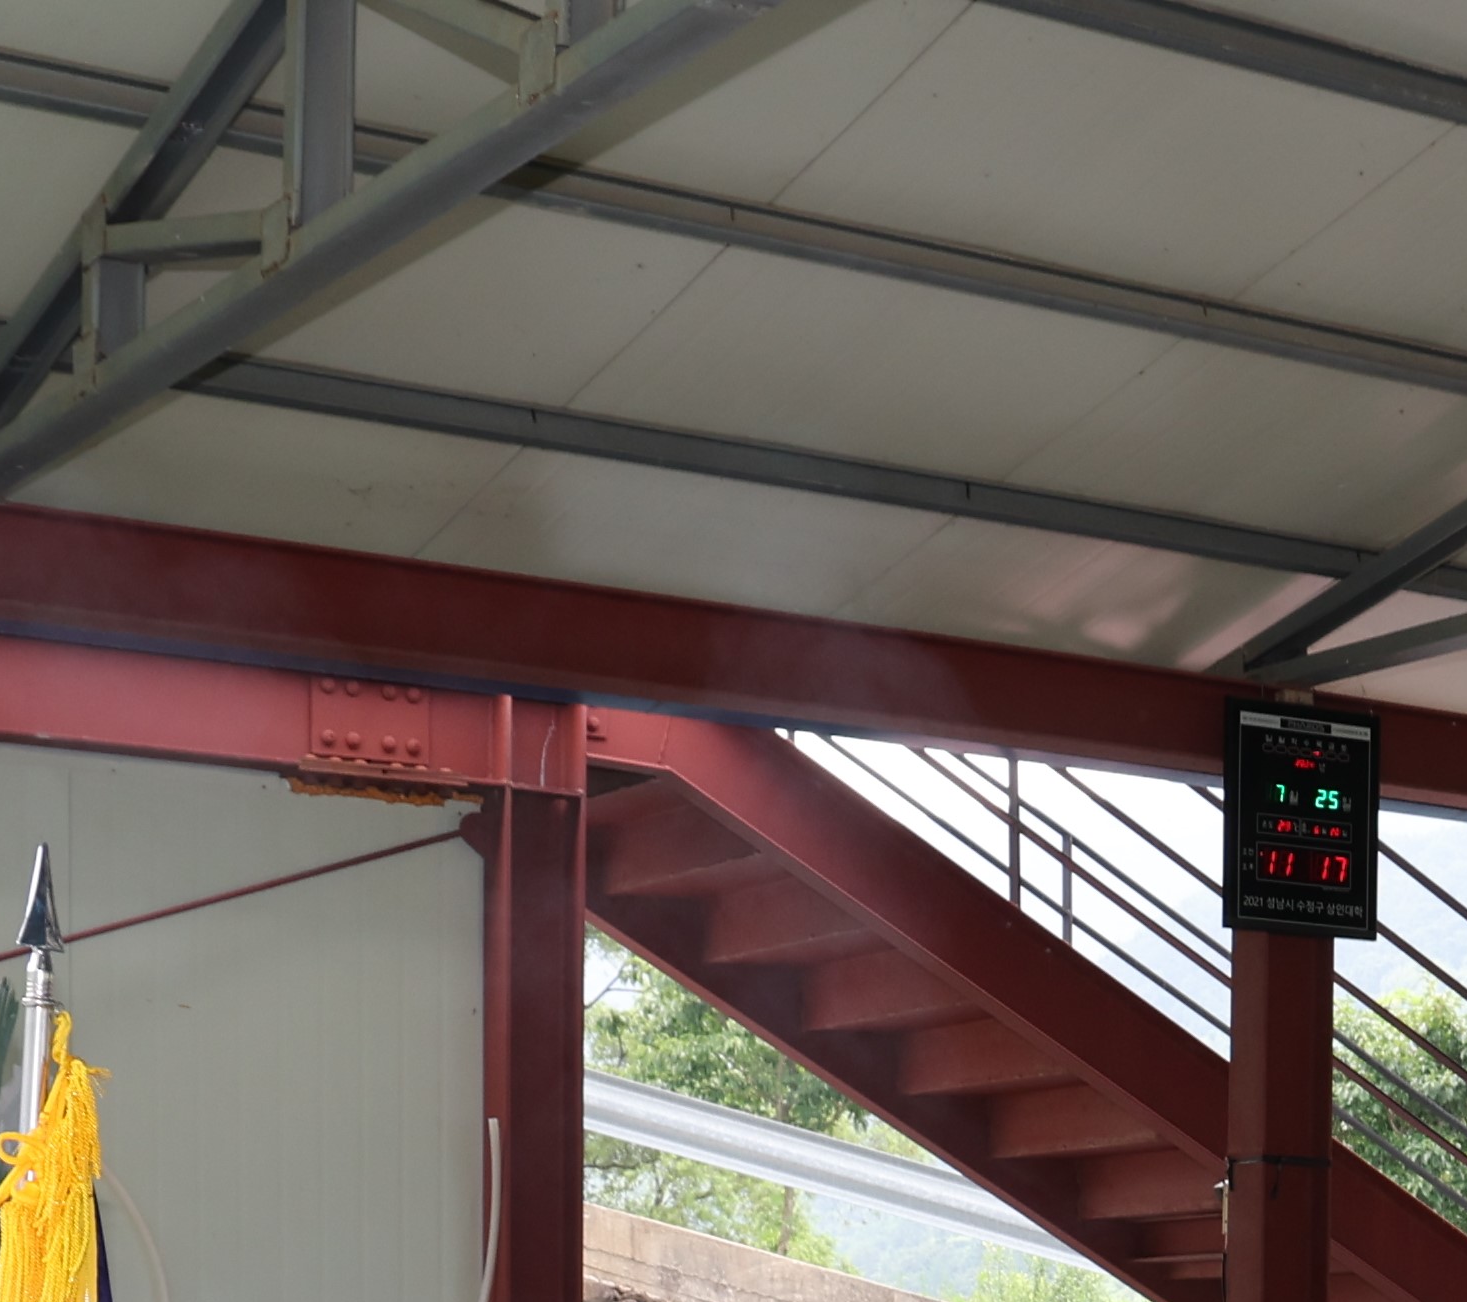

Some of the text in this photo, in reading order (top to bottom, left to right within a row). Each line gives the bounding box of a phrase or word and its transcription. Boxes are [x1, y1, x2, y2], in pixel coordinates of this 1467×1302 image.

[1276, 784, 1285, 803] 7
[1315, 789, 1339, 810] 25
[1269, 851, 1349, 882] 11 17
[1243, 895, 1264, 907] 2021
[1267, 897, 1294, 911] 성남시
[1297, 901, 1324, 914] 수정구
